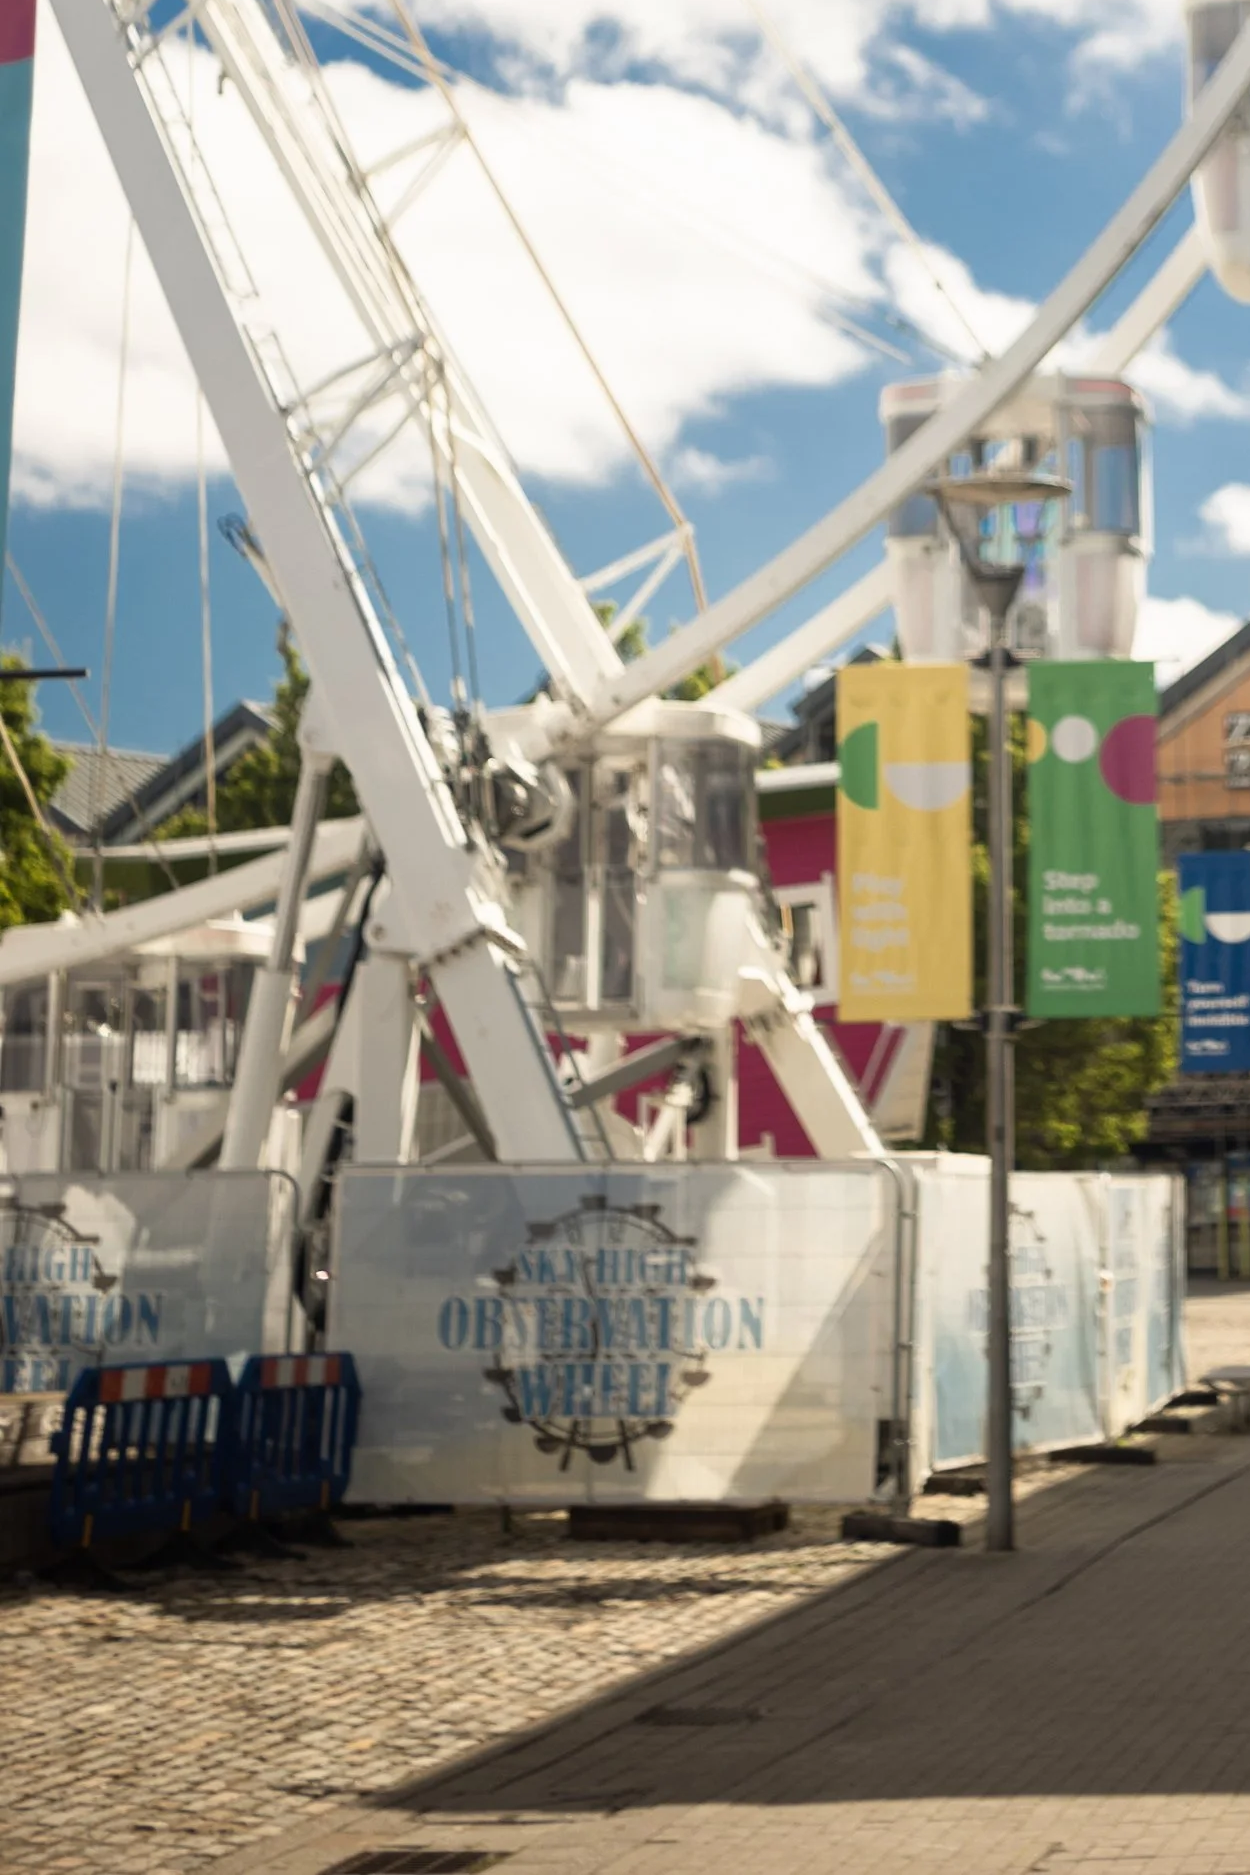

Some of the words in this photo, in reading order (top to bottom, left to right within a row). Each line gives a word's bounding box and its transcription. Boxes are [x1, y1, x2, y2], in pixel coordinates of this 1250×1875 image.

[1042, 870, 1098, 894] Step
[1042, 895, 1092, 915] into
[1096, 897, 1112, 915] a
[1043, 919, 1141, 941] tornado
[518, 1249, 580, 1284] SKY
[597, 1249, 689, 1284] HIGH
[437, 1296, 765, 1351] OBSERVATION
[517, 1363, 674, 1418] WHEEL
